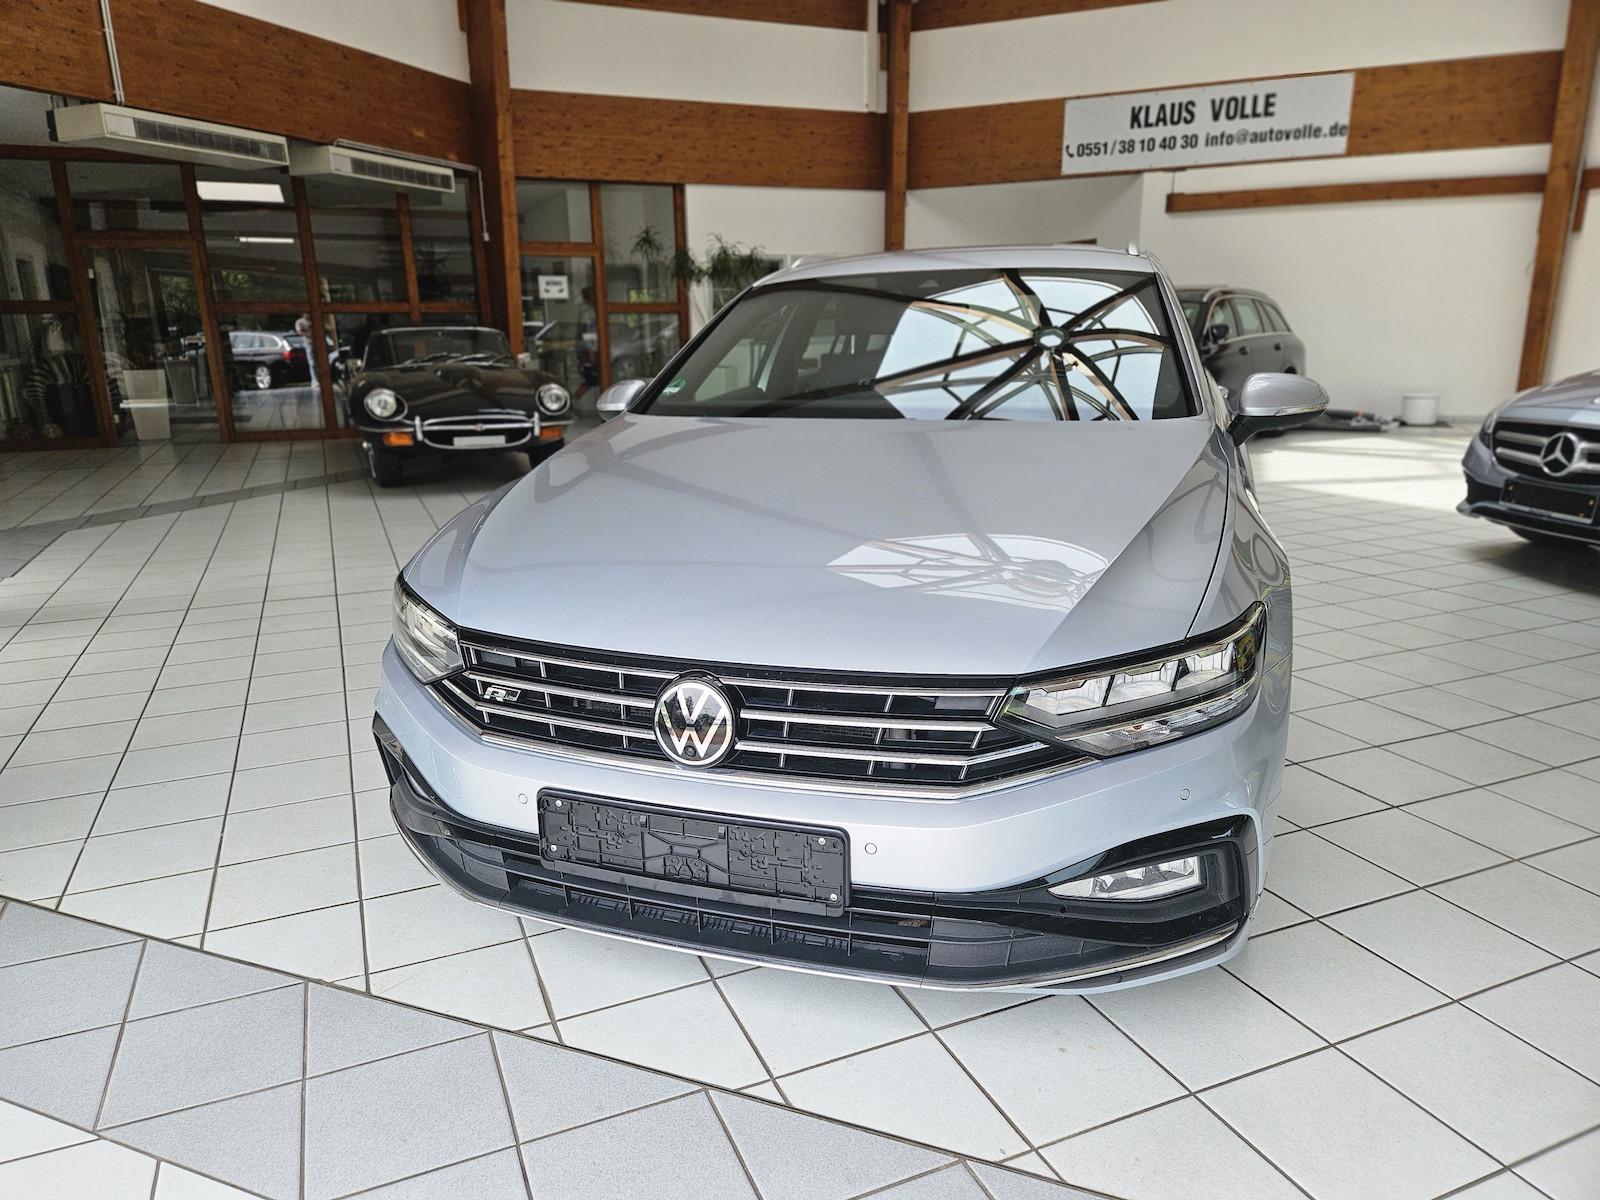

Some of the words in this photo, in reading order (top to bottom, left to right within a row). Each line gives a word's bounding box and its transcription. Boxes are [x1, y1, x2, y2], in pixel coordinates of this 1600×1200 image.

[1129, 100, 1197, 130] KLAUS
[1210, 92, 1277, 123] VOLLE
[1140, 137, 1156, 153] 10
[1158, 135, 1177, 151] 40
[1180, 133, 1199, 149] 30
[1204, 120, 1349, 148] info@autovolle.de
